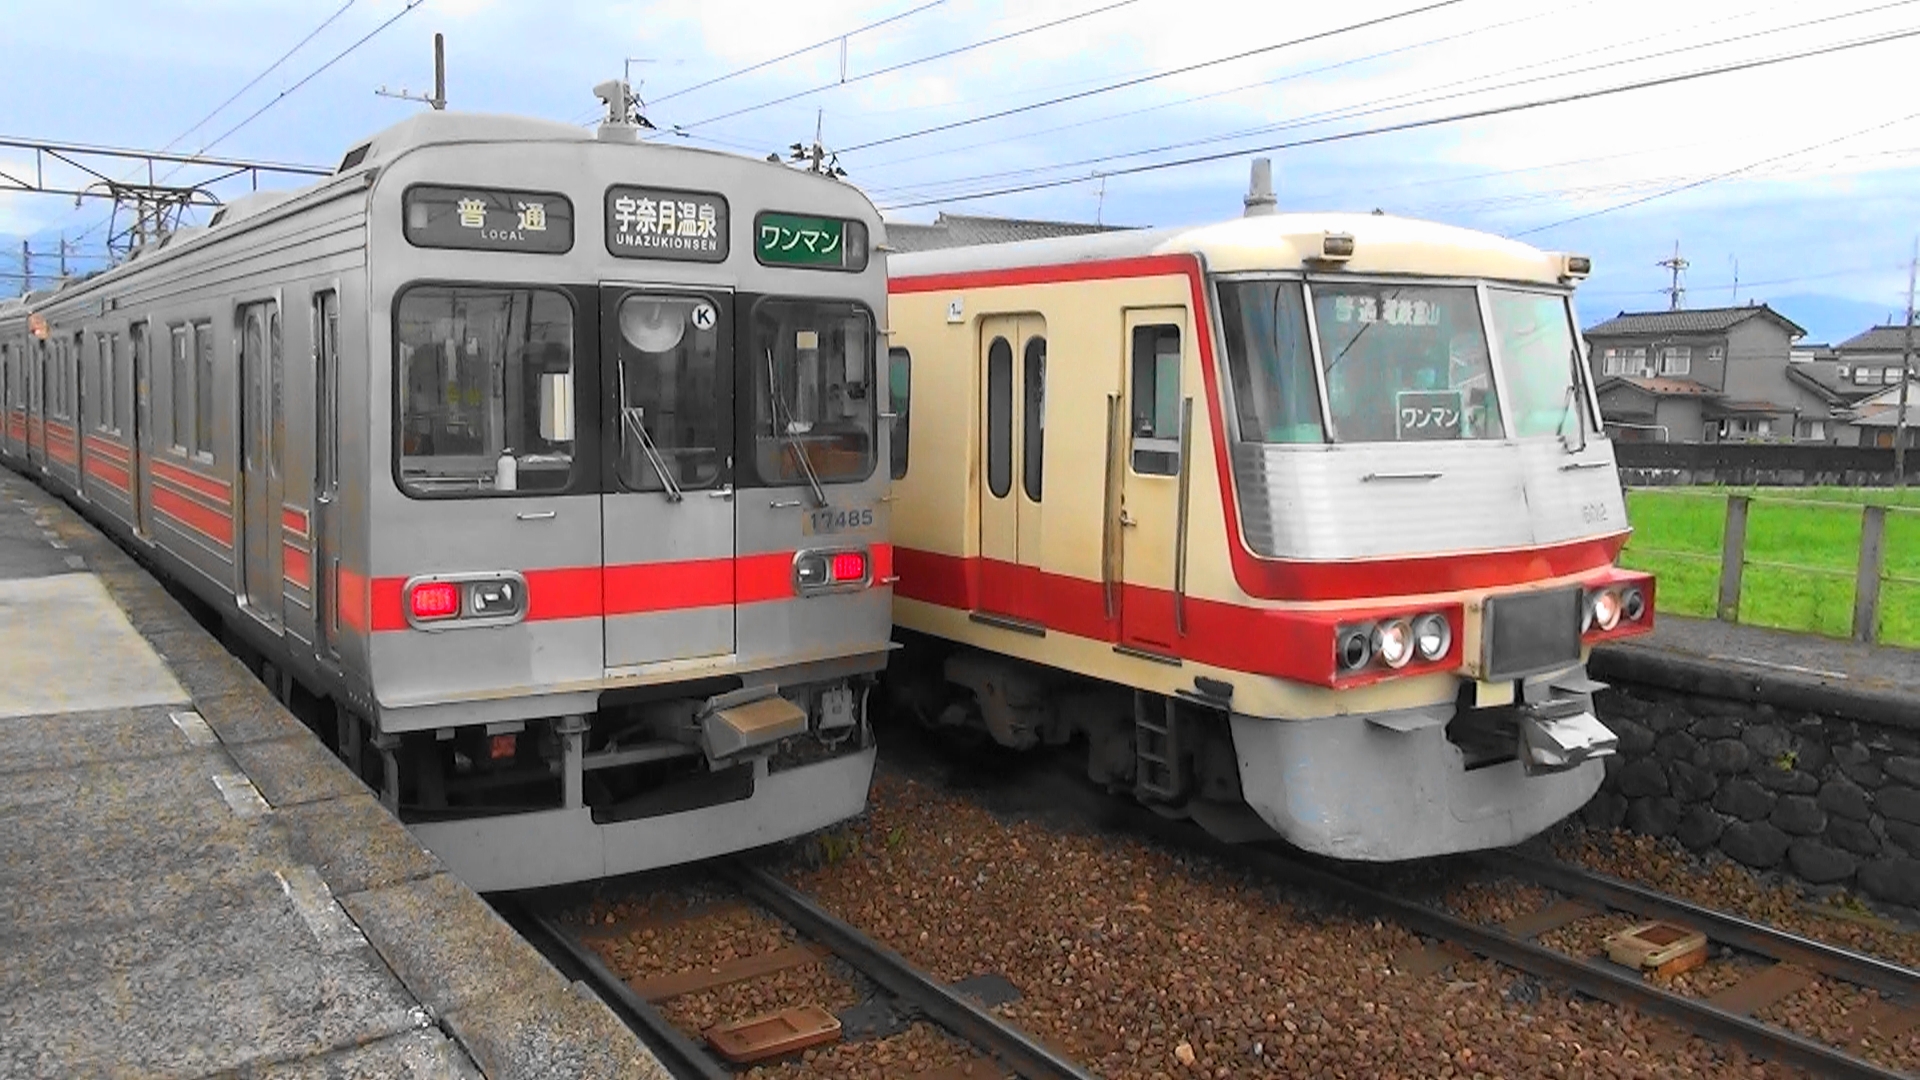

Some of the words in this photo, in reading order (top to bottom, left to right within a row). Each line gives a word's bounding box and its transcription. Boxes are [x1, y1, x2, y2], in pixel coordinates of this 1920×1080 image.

[457, 198, 547, 231] 普通
[615, 195, 717, 238] 宇奈月温泉
[481, 229, 525, 241] LOCAL
[615, 233, 717, 251] UNAZUKIONSEN
[761, 225, 840, 254] ワンマン
[697, 308, 711, 325] K
[1401, 407, 1460, 429] ワンマン
[810, 508, 873, 531] 17485
